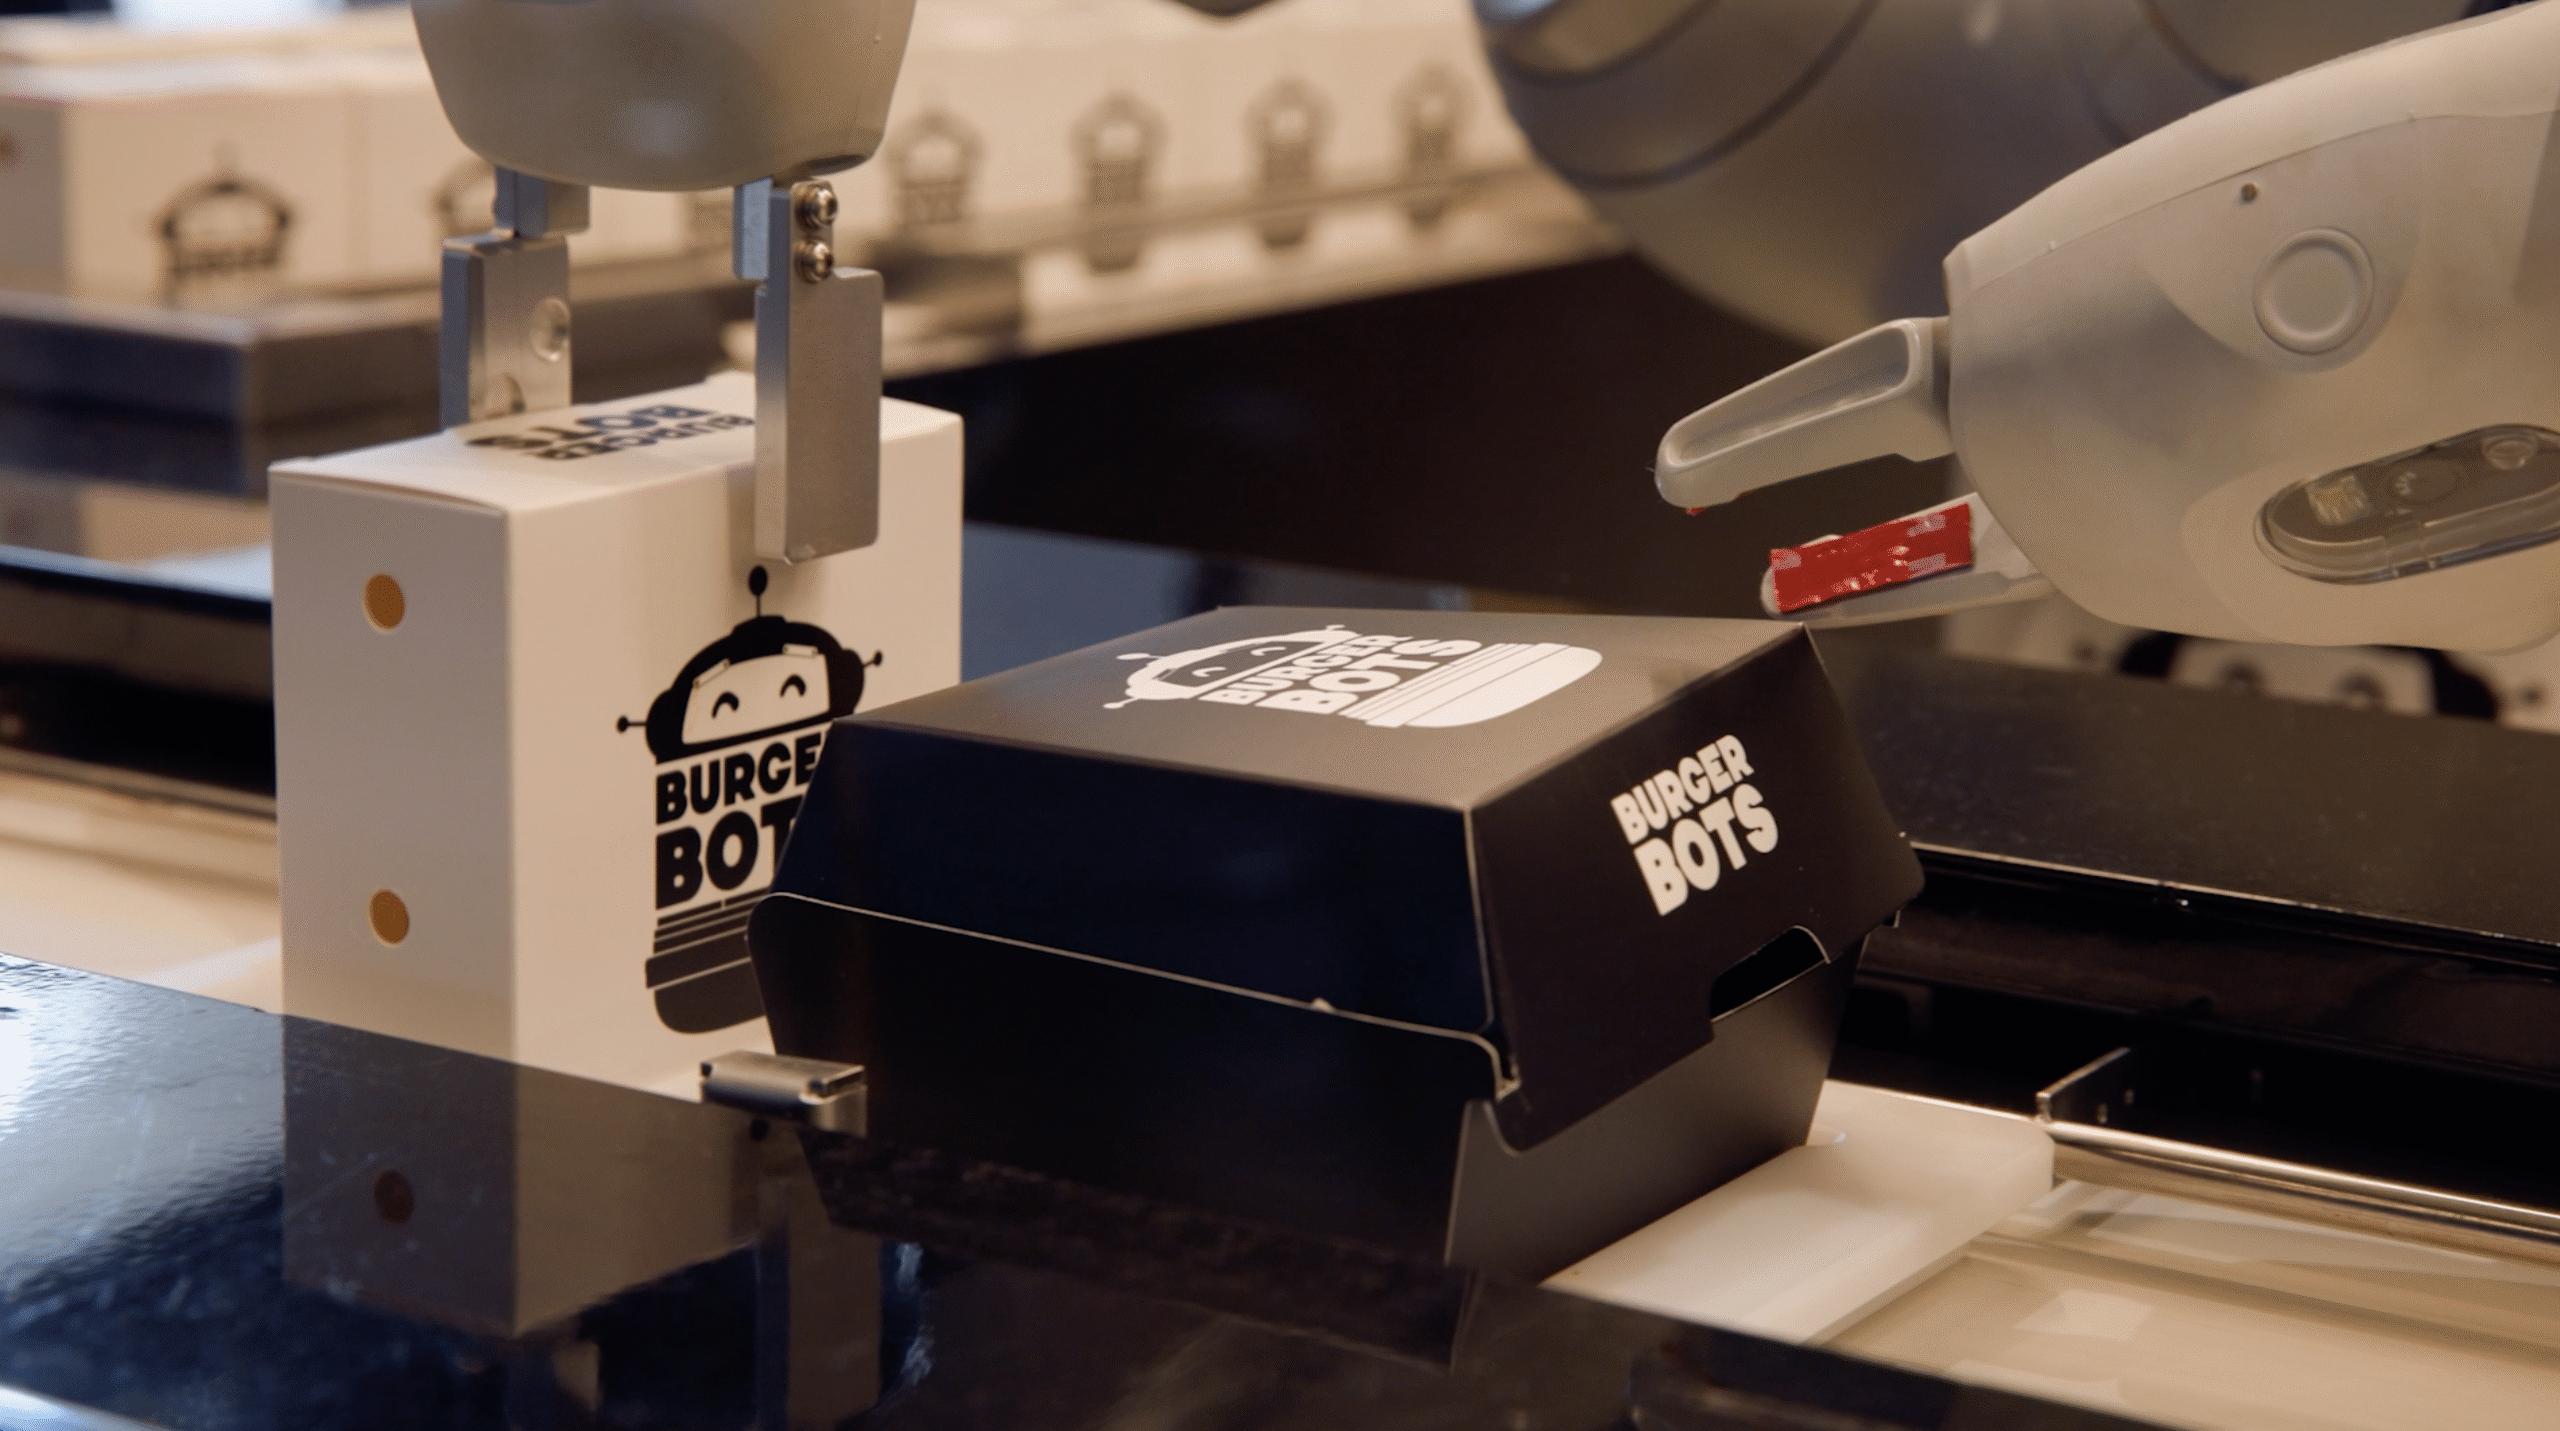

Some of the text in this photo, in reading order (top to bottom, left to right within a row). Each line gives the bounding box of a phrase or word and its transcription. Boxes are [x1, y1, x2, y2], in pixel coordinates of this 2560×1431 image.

[1198, 635, 1414, 705] BURGER
[1254, 639, 1482, 715] BOTS
[656, 731, 822, 826] BURGE
[1611, 735, 1754, 845] BURGER
[656, 795, 805, 911] BOT
[1633, 783, 1779, 916] BOTS
